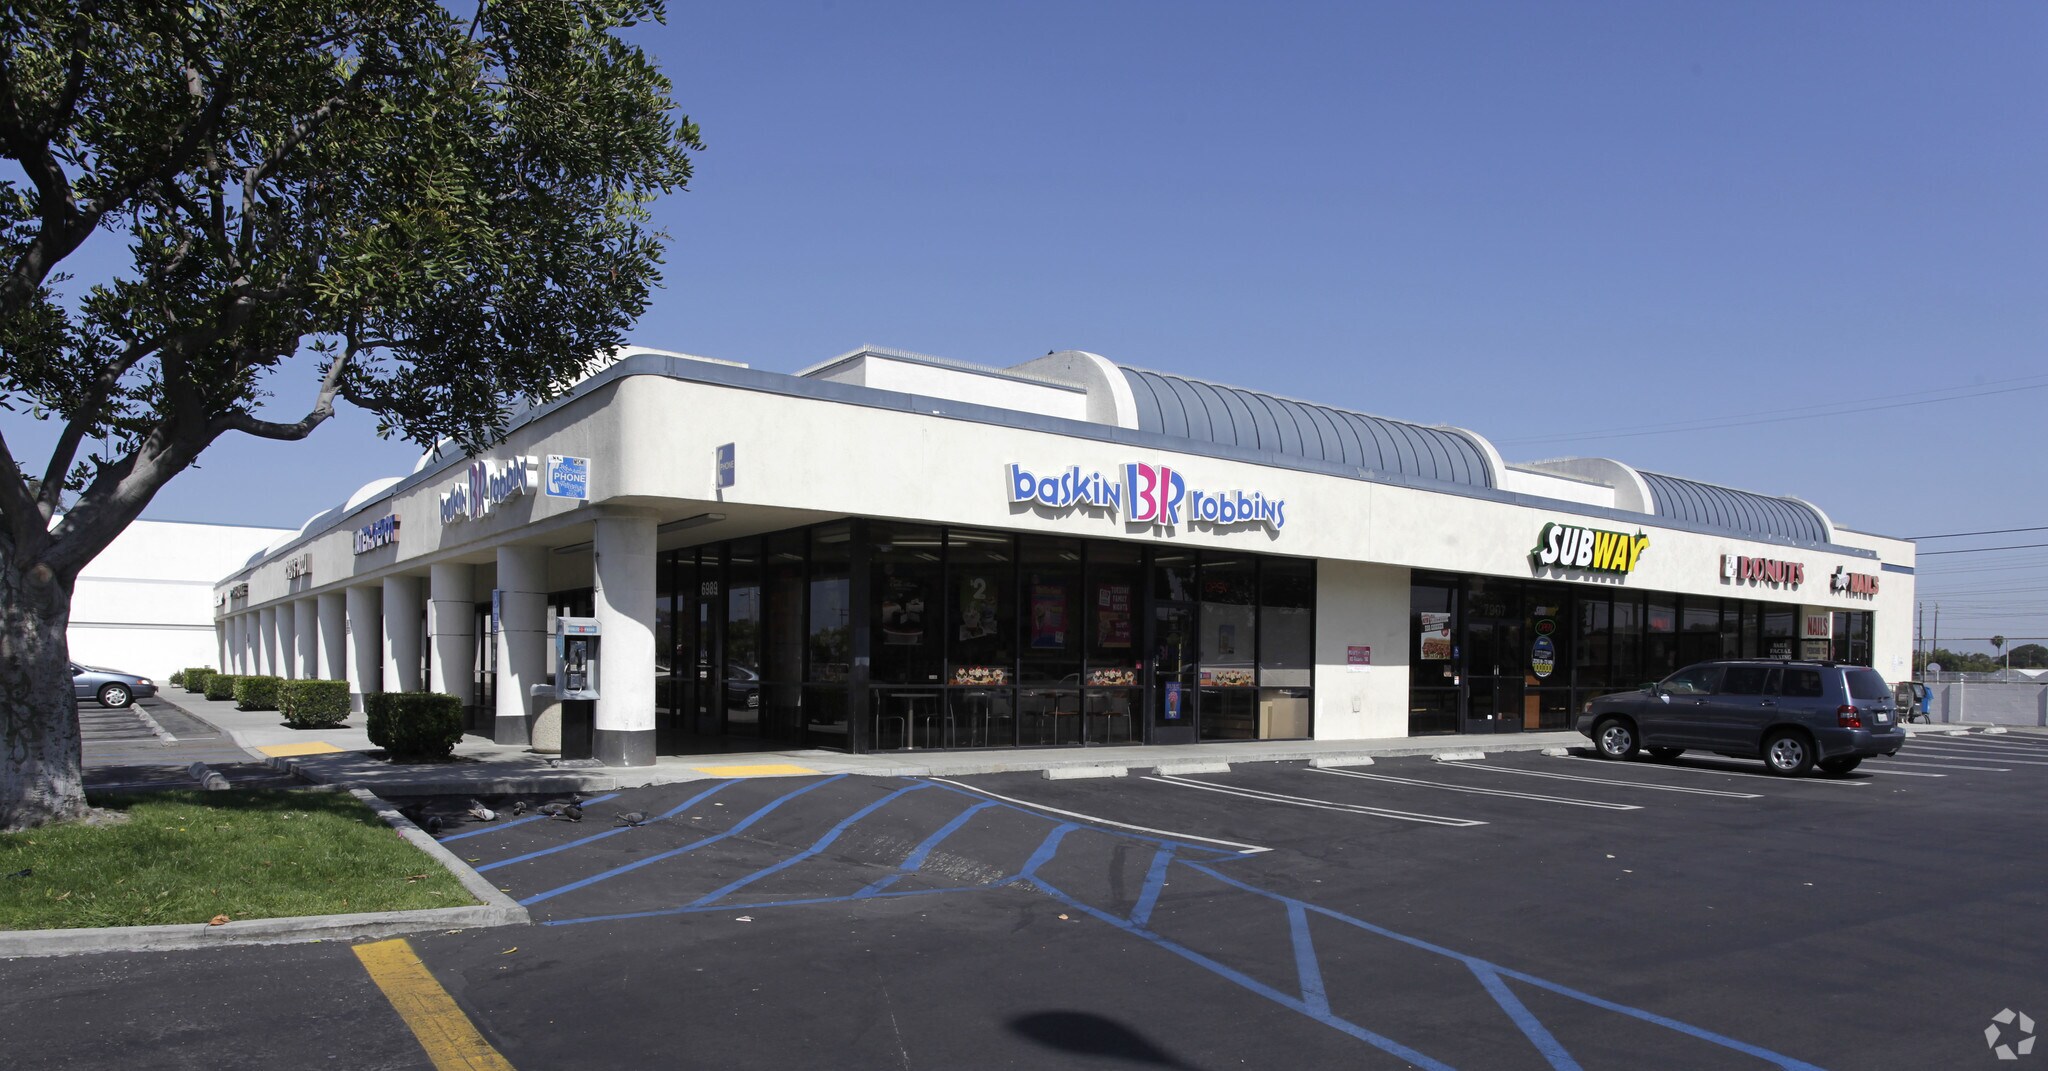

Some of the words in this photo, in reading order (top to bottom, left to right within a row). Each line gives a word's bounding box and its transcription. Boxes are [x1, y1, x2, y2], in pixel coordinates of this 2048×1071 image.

[720, 459, 735, 471] PHONE
[554, 472, 586, 483] PHONE
[1010, 462, 1121, 513] baskin
[1124, 462, 1186, 525] BR
[1192, 488, 1286, 530] robbins
[1539, 525, 1651, 572] SUBWAY
[1740, 555, 1805, 585] DONUTS
[1851, 572, 1880, 595] NAILS
[1807, 616, 1829, 636] NAILS
